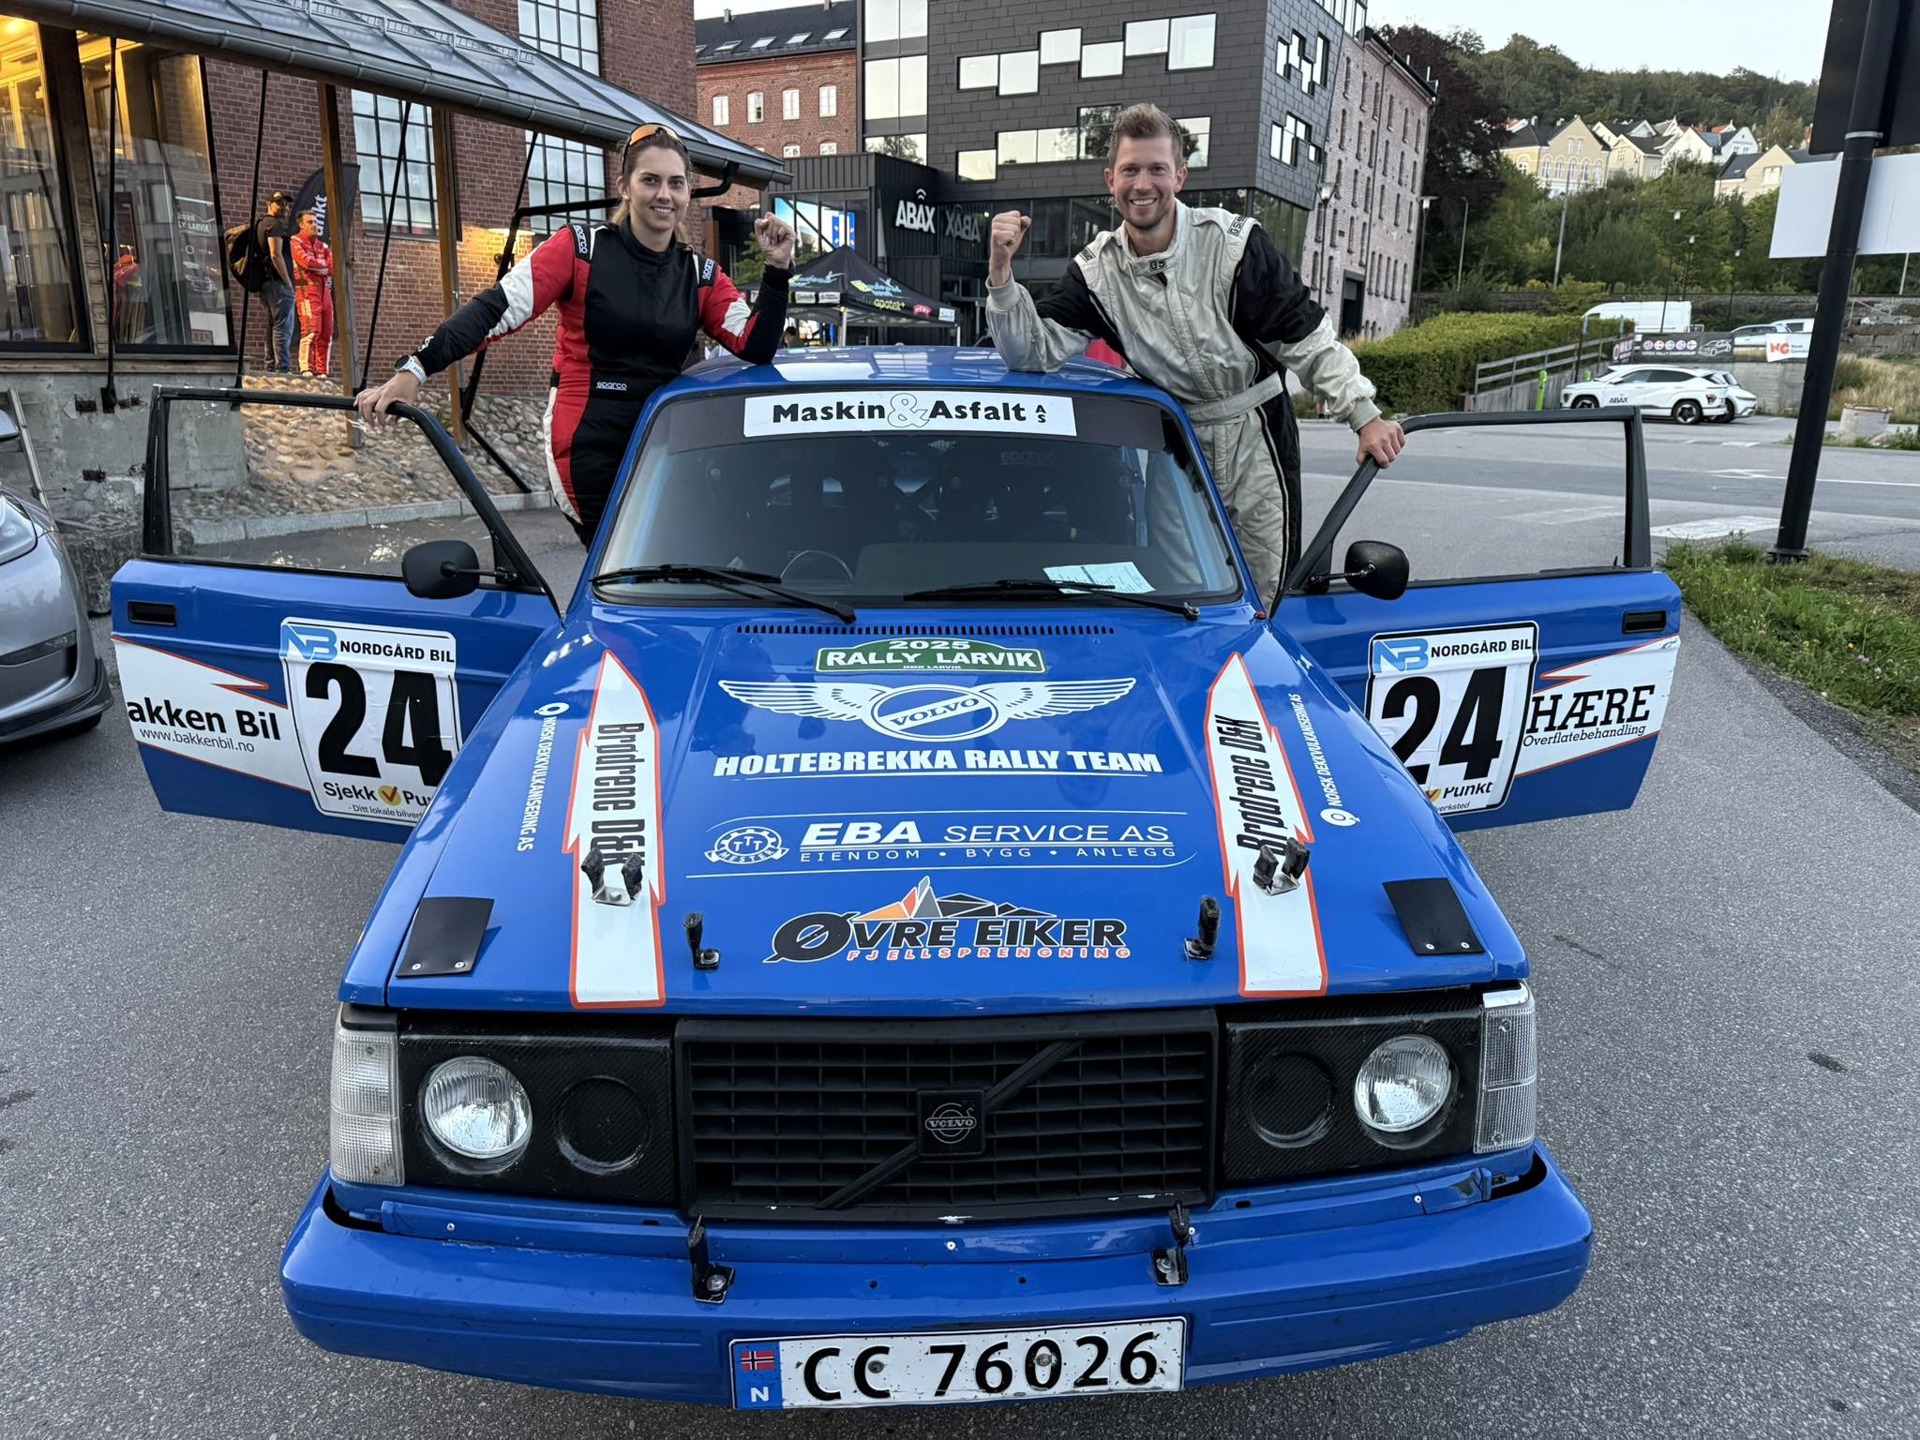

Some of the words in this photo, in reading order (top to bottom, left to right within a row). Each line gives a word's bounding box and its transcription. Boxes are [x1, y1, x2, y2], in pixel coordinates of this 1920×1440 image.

[895, 200, 936, 234] ABAX
[772, 400, 885, 423] Maskin
[887, 393, 930, 428] &
[928, 400, 1027, 422] Asfalt
[340, 640, 425, 660] NORDGÅRD
[430, 649, 455, 663] BIL
[889, 640, 971, 650] 2025
[1431, 639, 1507, 659] NORDGÅRD
[1511, 638, 1532, 651] BIL
[826, 652, 921, 667] RALLY
[937, 651, 1037, 667] LARVIK
[126, 697, 227, 734] akken
[235, 709, 281, 741] Bil
[889, 697, 980, 727] VOLVO
[1526, 684, 1656, 734] HÆRE
[306, 662, 453, 787] 24
[540, 716, 557, 743] NORSK
[1214, 714, 1267, 754] D&K
[1381, 667, 1508, 785] 24
[1522, 724, 1647, 748] Overflatebehandling
[140, 728, 255, 753] www.bakkenbil.no
[593, 722, 645, 812] Brødrene
[713, 750, 958, 777] HOLTEBREKKA
[964, 750, 1059, 769] RALLY
[1067, 751, 1163, 773] TEAM
[323, 782, 378, 802] Sjekk
[520, 742, 552, 835] DEKKVULKANISERING
[1319, 776, 1343, 807] NORSK
[369, 805, 395, 817] lokale
[1229, 754, 1288, 857] Brødrene
[1436, 800, 1470, 812] verksted
[517, 836, 534, 851] AS
[800, 820, 922, 845] EBA
[943, 825, 1110, 842] SERVICE
[1118, 825, 1170, 841] AS
[721, 849, 774, 864] MESTER
[800, 849, 920, 863] EIENDOM
[966, 848, 1032, 858] BYGG
[1076, 847, 1176, 858] ANLEGG
[763, 911, 959, 964] ØVRE
[974, 918, 1127, 948] EIKER
[847, 947, 1131, 961] FJELLSPRENGNING
[928, 1118, 974, 1128] VOLVO
[803, 1344, 891, 1400] CC
[926, 1331, 1160, 1397] 76026
[751, 1387, 770, 1402] N
